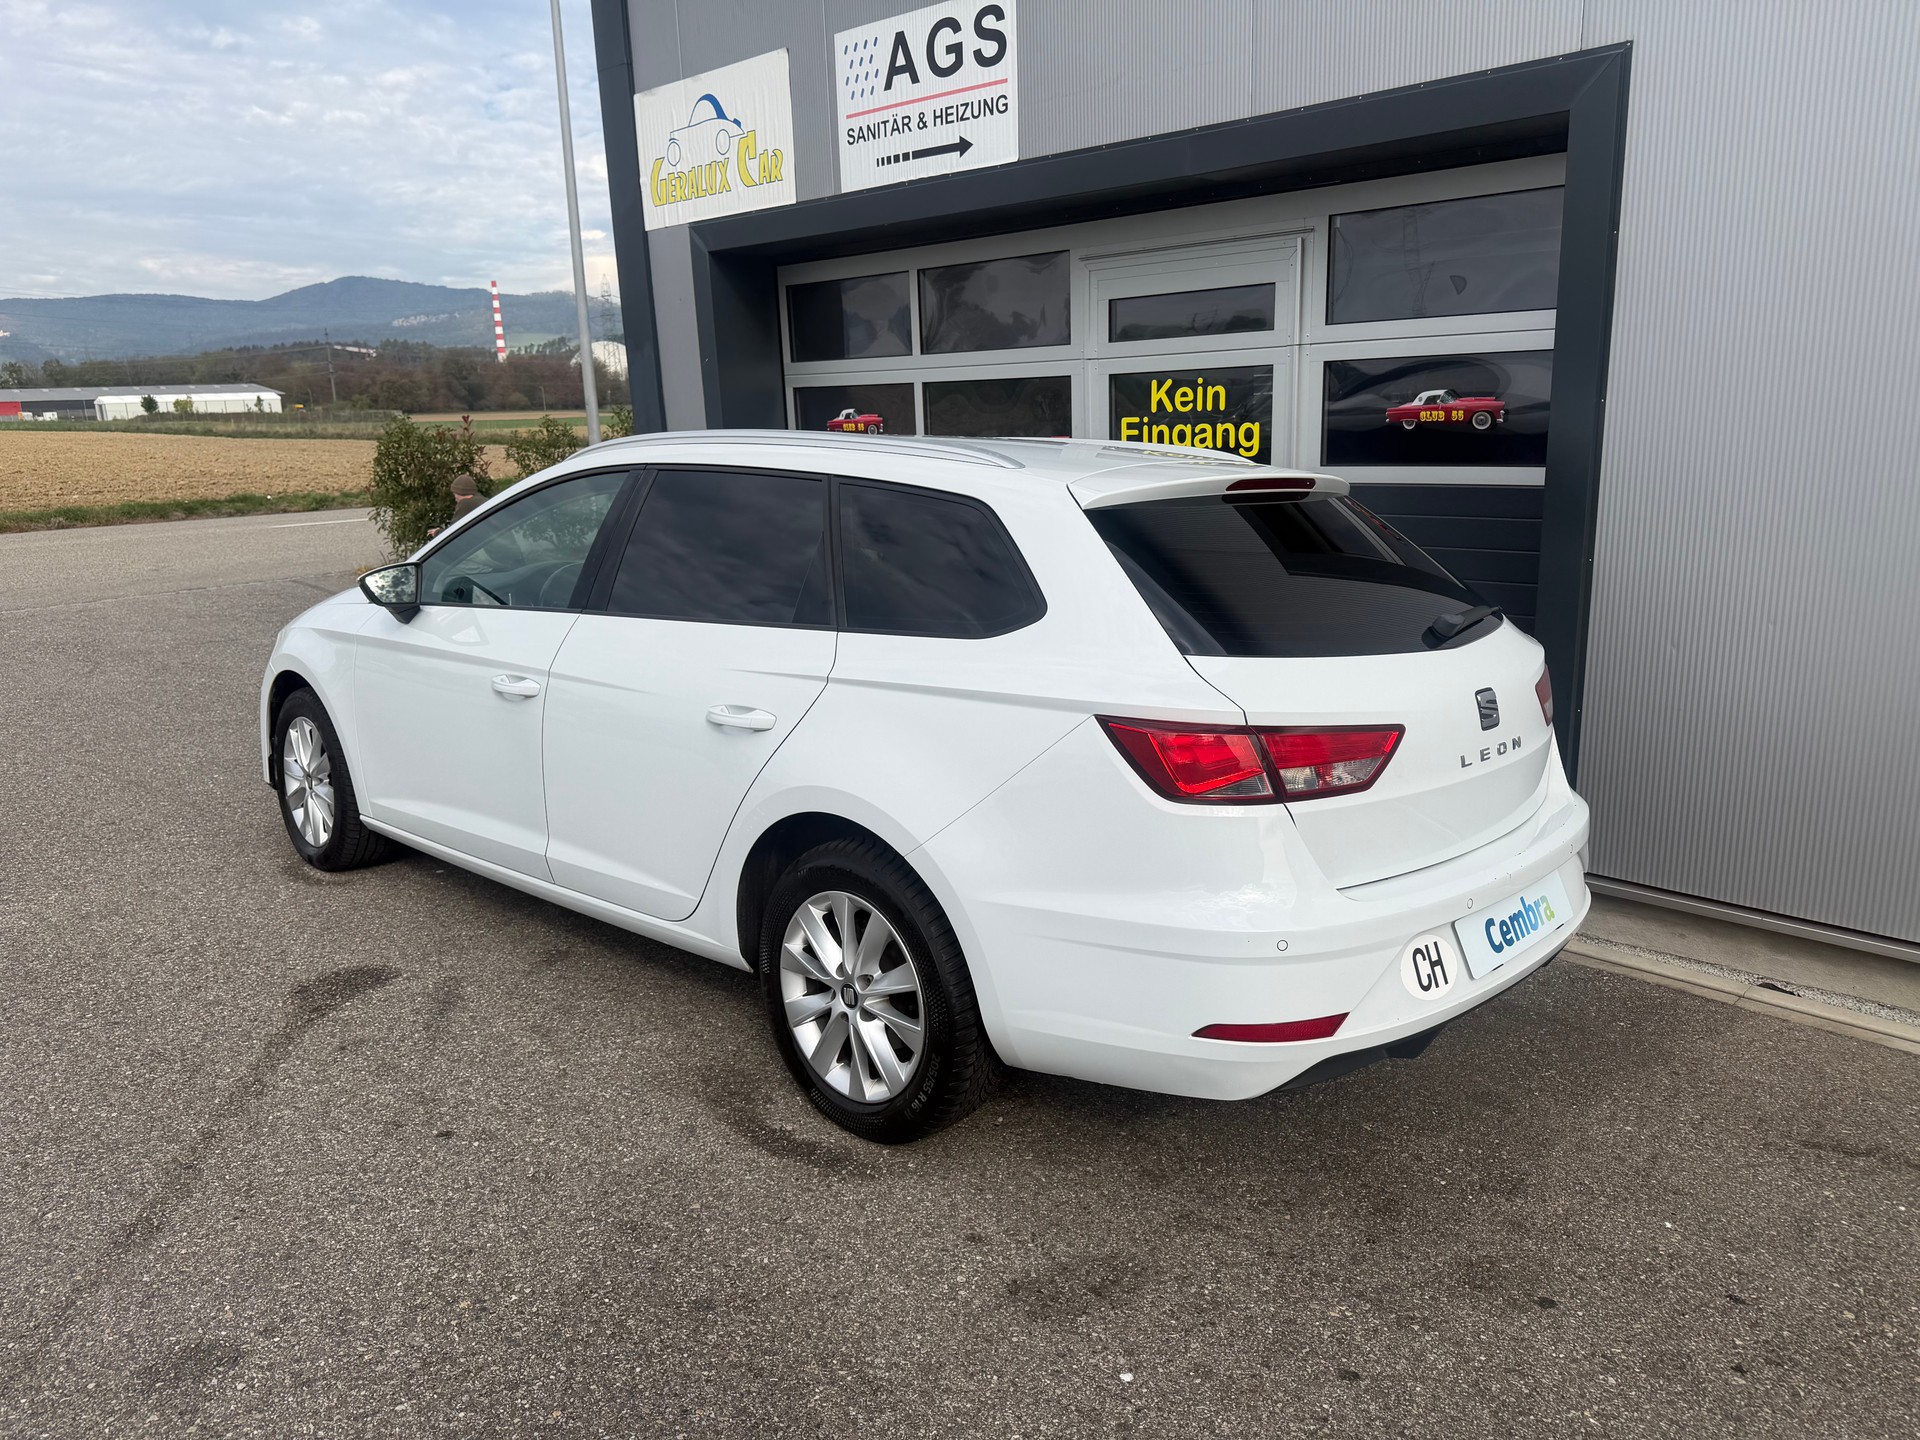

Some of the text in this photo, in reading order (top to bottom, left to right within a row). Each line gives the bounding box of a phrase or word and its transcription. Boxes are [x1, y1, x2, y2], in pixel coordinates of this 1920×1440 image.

[884, 4, 1008, 91] AGS
[846, 94, 1009, 146] SANITÄR & HEIZUNG
[1151, 377, 1226, 413] Kein
[1451, 410, 1464, 421] 55
[1121, 416, 1260, 457] Eingang
[1460, 735, 1521, 768] LEON
[1485, 895, 1555, 953] Cembra
[1412, 941, 1449, 992] CH
